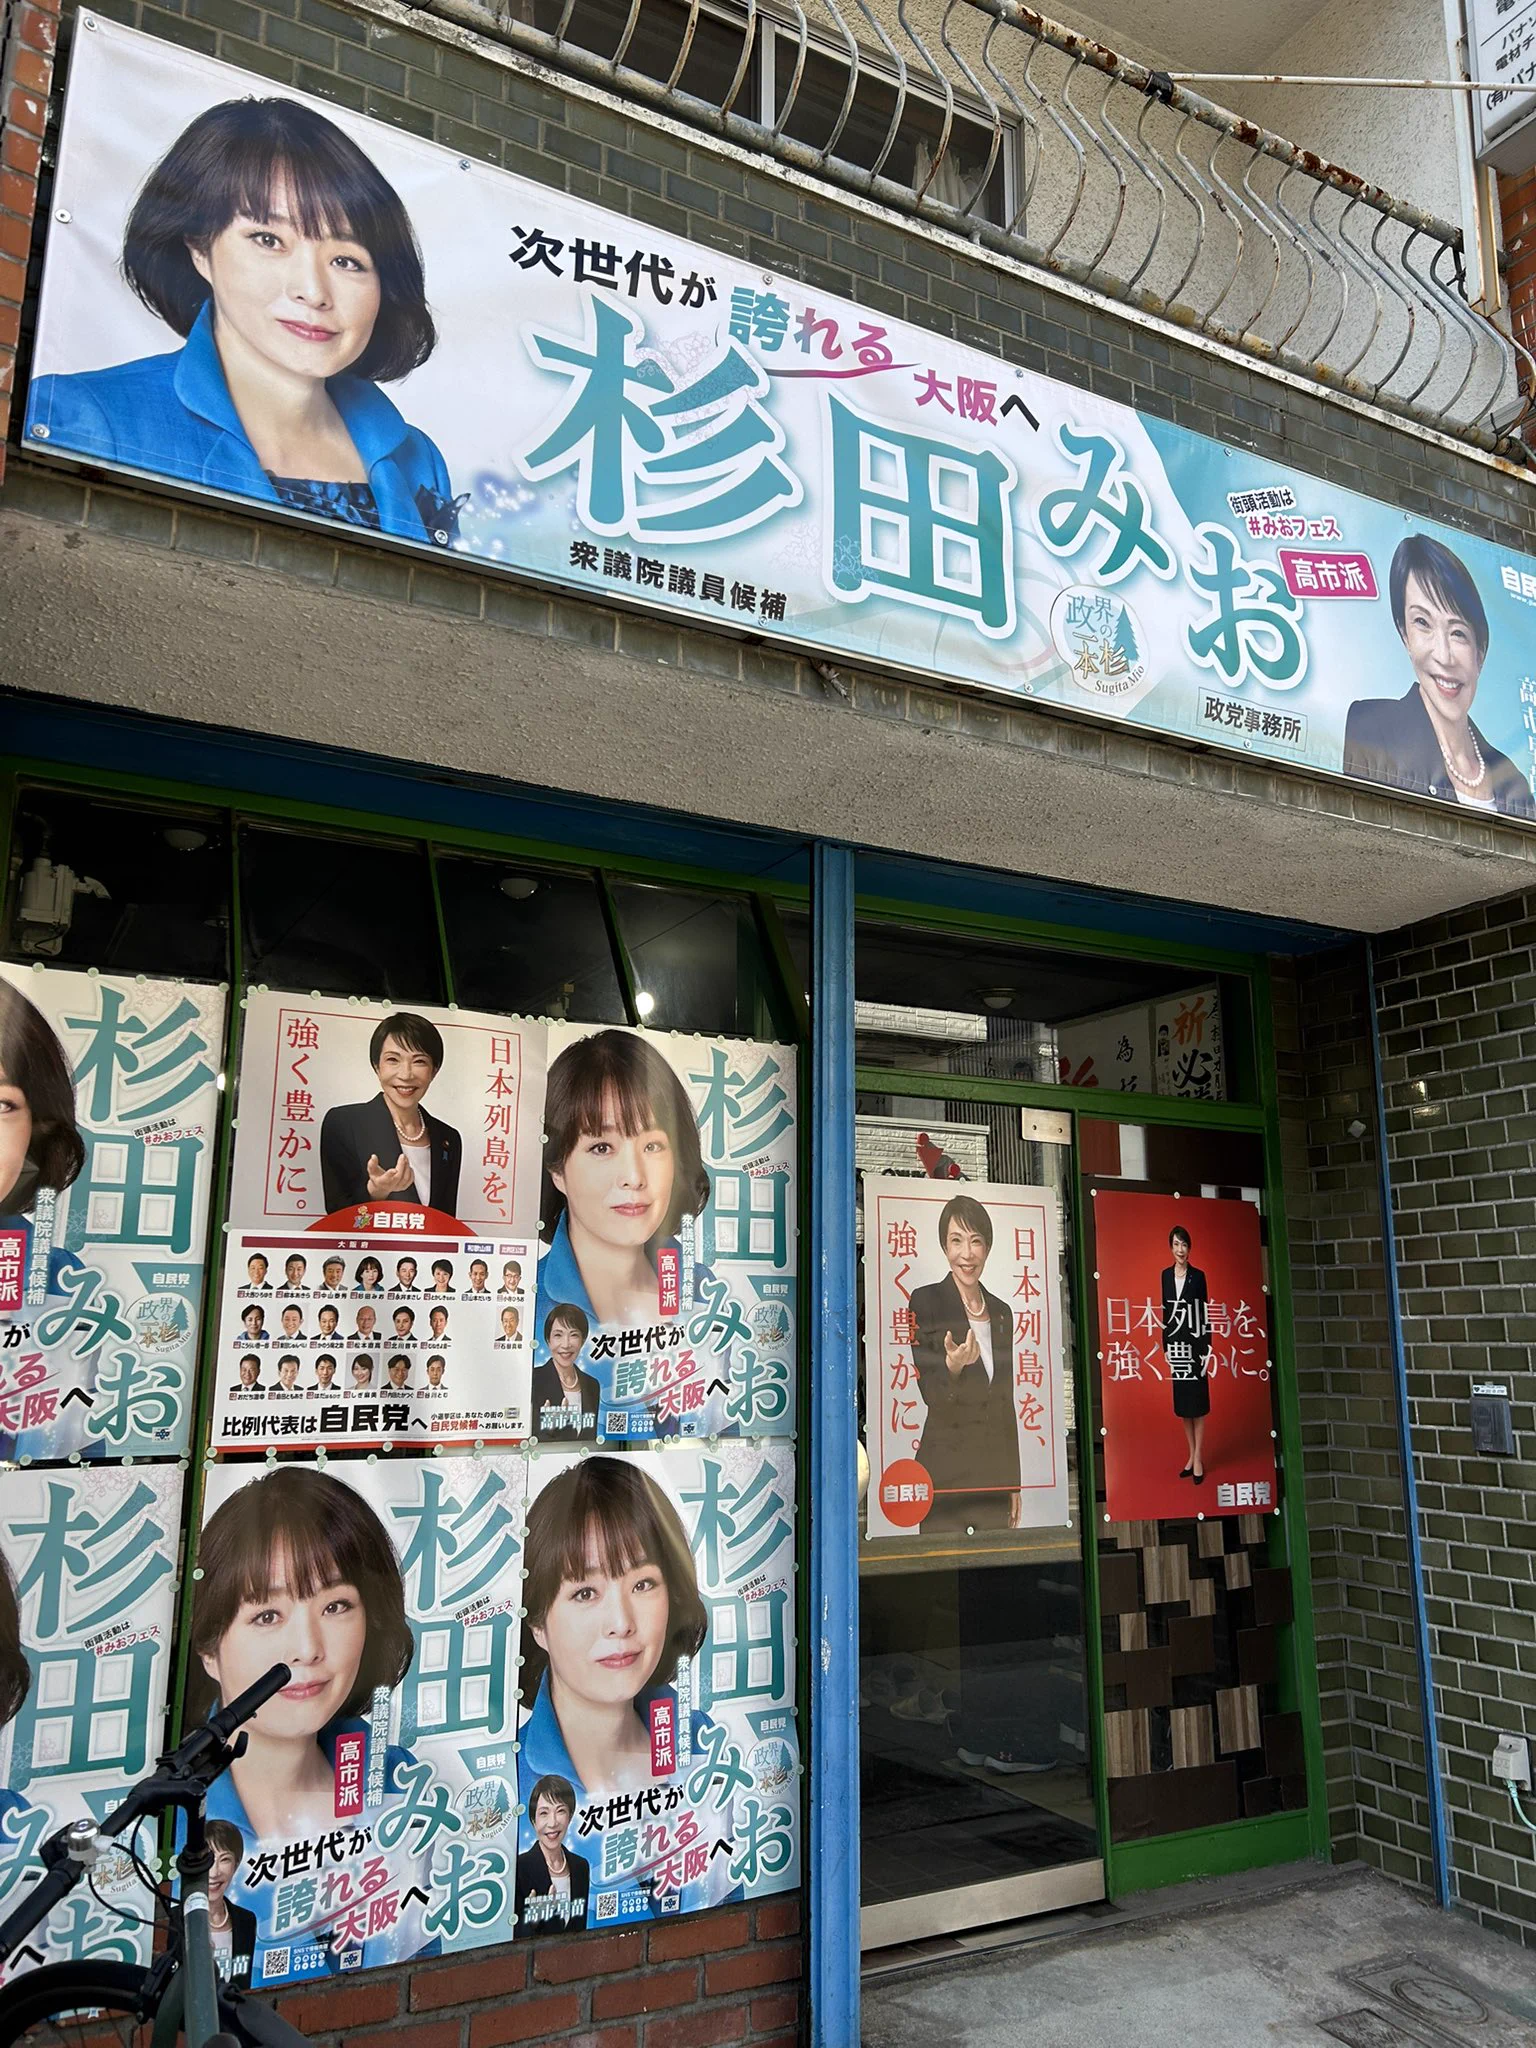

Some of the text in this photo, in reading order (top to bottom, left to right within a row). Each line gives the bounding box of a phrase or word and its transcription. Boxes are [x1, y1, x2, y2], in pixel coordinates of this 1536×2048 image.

[509, 225, 1040, 432] 次世代が 誇れる 大阪へ
[524, 292, 1298, 682] 杉田みお
[1229, 489, 1294, 515] 街頭活動は
[1248, 515, 1341, 539] #みおフェス
[569, 540, 786, 622] 衆議院議員候補
[1291, 557, 1369, 593] 高市派
[1094, 664, 1146, 697] Sugita Mio
[1203, 696, 1302, 744] 政党事務所
[134, 1118, 177, 1139] 街頭活動は
[144, 1125, 205, 1146] #みおフェス
[276, 1017, 320, 1210] 強く豊かに。
[481, 1036, 514, 1218] 日本列島を、
[749, 1161, 790, 1179] #みおフェス
[39, 984, 215, 1441] 杉田みお
[373, 1212, 426, 1231] 自民党
[688, 1047, 794, 1423] 杉田みお
[0, 1237, 22, 1302] 高市派
[27, 1188, 56, 1305] 衆議院議員候補
[681, 1214, 695, 1311] 衆議院議員候補
[152, 1272, 191, 1285] 自民党
[660, 1255, 676, 1309] 高市派
[2, 1322, 31, 1349] が
[589, 1323, 685, 1360] 次世代が
[886, 1219, 921, 1452] 強く豊かに。
[1012, 1226, 1047, 1448] 日本列島を、
[1106, 1296, 1267, 1339] 日本列島を、
[615, 1349, 697, 1399] 誇れる
[1106, 1340, 1270, 1382] 強く豊かに。
[222, 1404, 428, 1437] 比例代表は自民党へ
[657, 1377, 731, 1423] 大阪へ
[883, 1482, 929, 1504] 自民党
[1217, 1481, 1271, 1507] 自民党
[463, 1599, 513, 1628] #みおフェス
[743, 1578, 788, 1603] #みおフェス
[84, 1620, 131, 1650] 街頭活動は
[95, 1625, 161, 1656] #みおフェス
[680, 1458, 793, 1886] 杉田みお
[378, 1468, 521, 1939] 杉田みお
[677, 1655, 691, 1767] 衆議院議員候補
[366, 1685, 391, 1807] 衆議院議員候補
[476, 1752, 506, 1770] 自民党
[654, 1705, 674, 1767] 高市派
[338, 1740, 361, 1807] 高市派
[577, 1784, 686, 1837] 次世代が
[244, 1828, 372, 1888] 次世代が
[604, 1811, 700, 1878] 誇れる
[655, 1837, 734, 1898] 大阪へ
[110, 1878, 137, 1893] Sugita
[275, 1856, 390, 1932] 誇れる
[330, 1886, 430, 1954] 大阪へ
